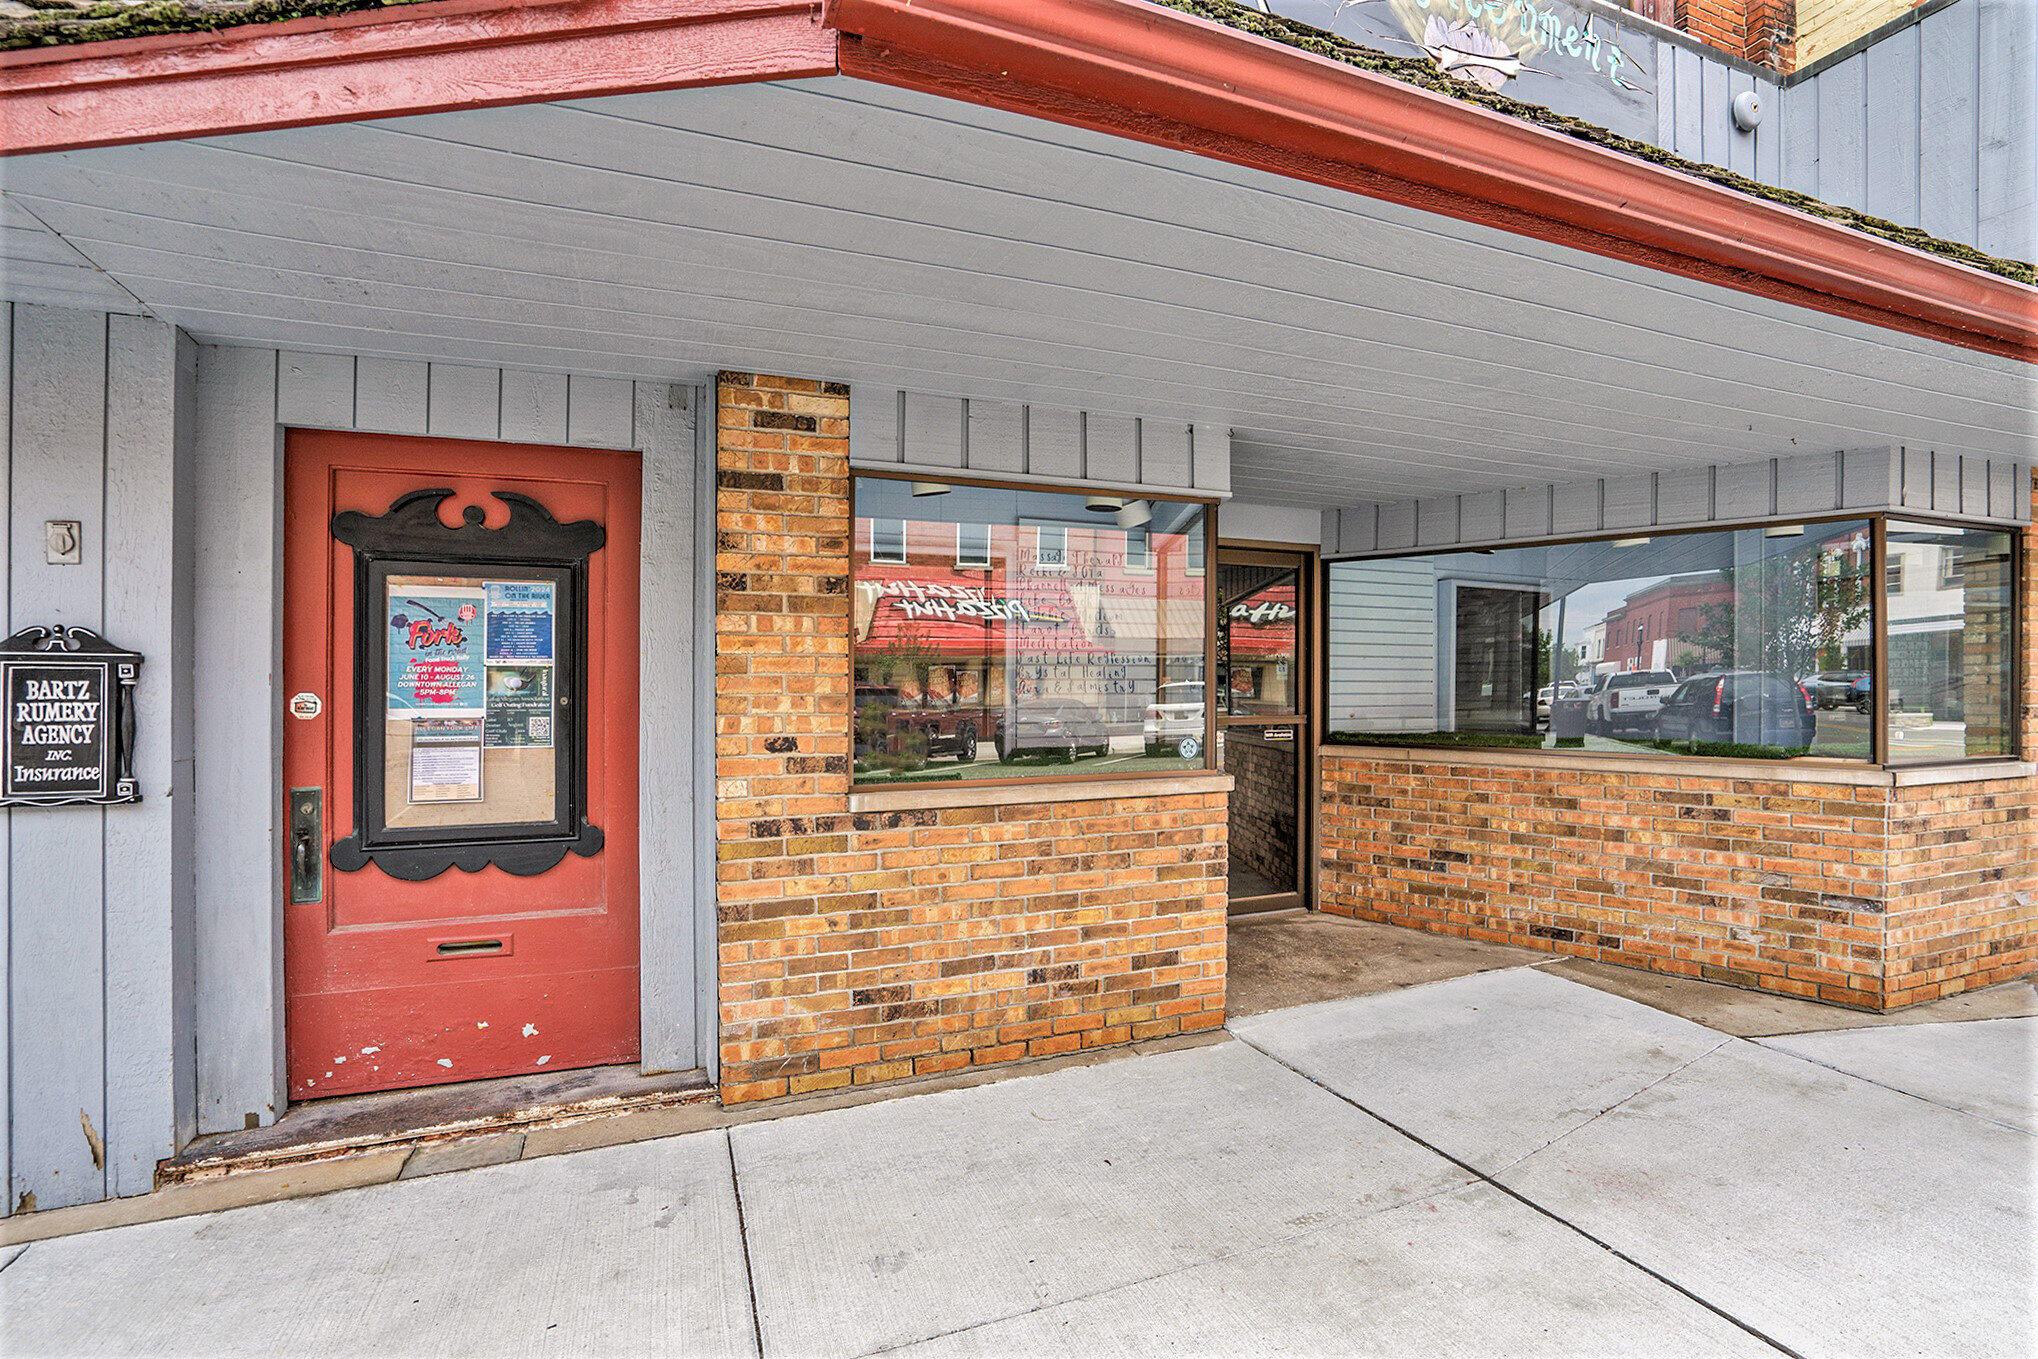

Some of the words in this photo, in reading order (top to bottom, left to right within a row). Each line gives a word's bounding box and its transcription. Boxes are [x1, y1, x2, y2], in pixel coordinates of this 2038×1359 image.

[408, 619, 464, 650] Fork
[26, 680, 90, 700] BARTZ
[16, 702, 100, 722] RUMERY
[21, 725, 95, 744] AGENCY
[14, 765, 100, 782] Insurance
